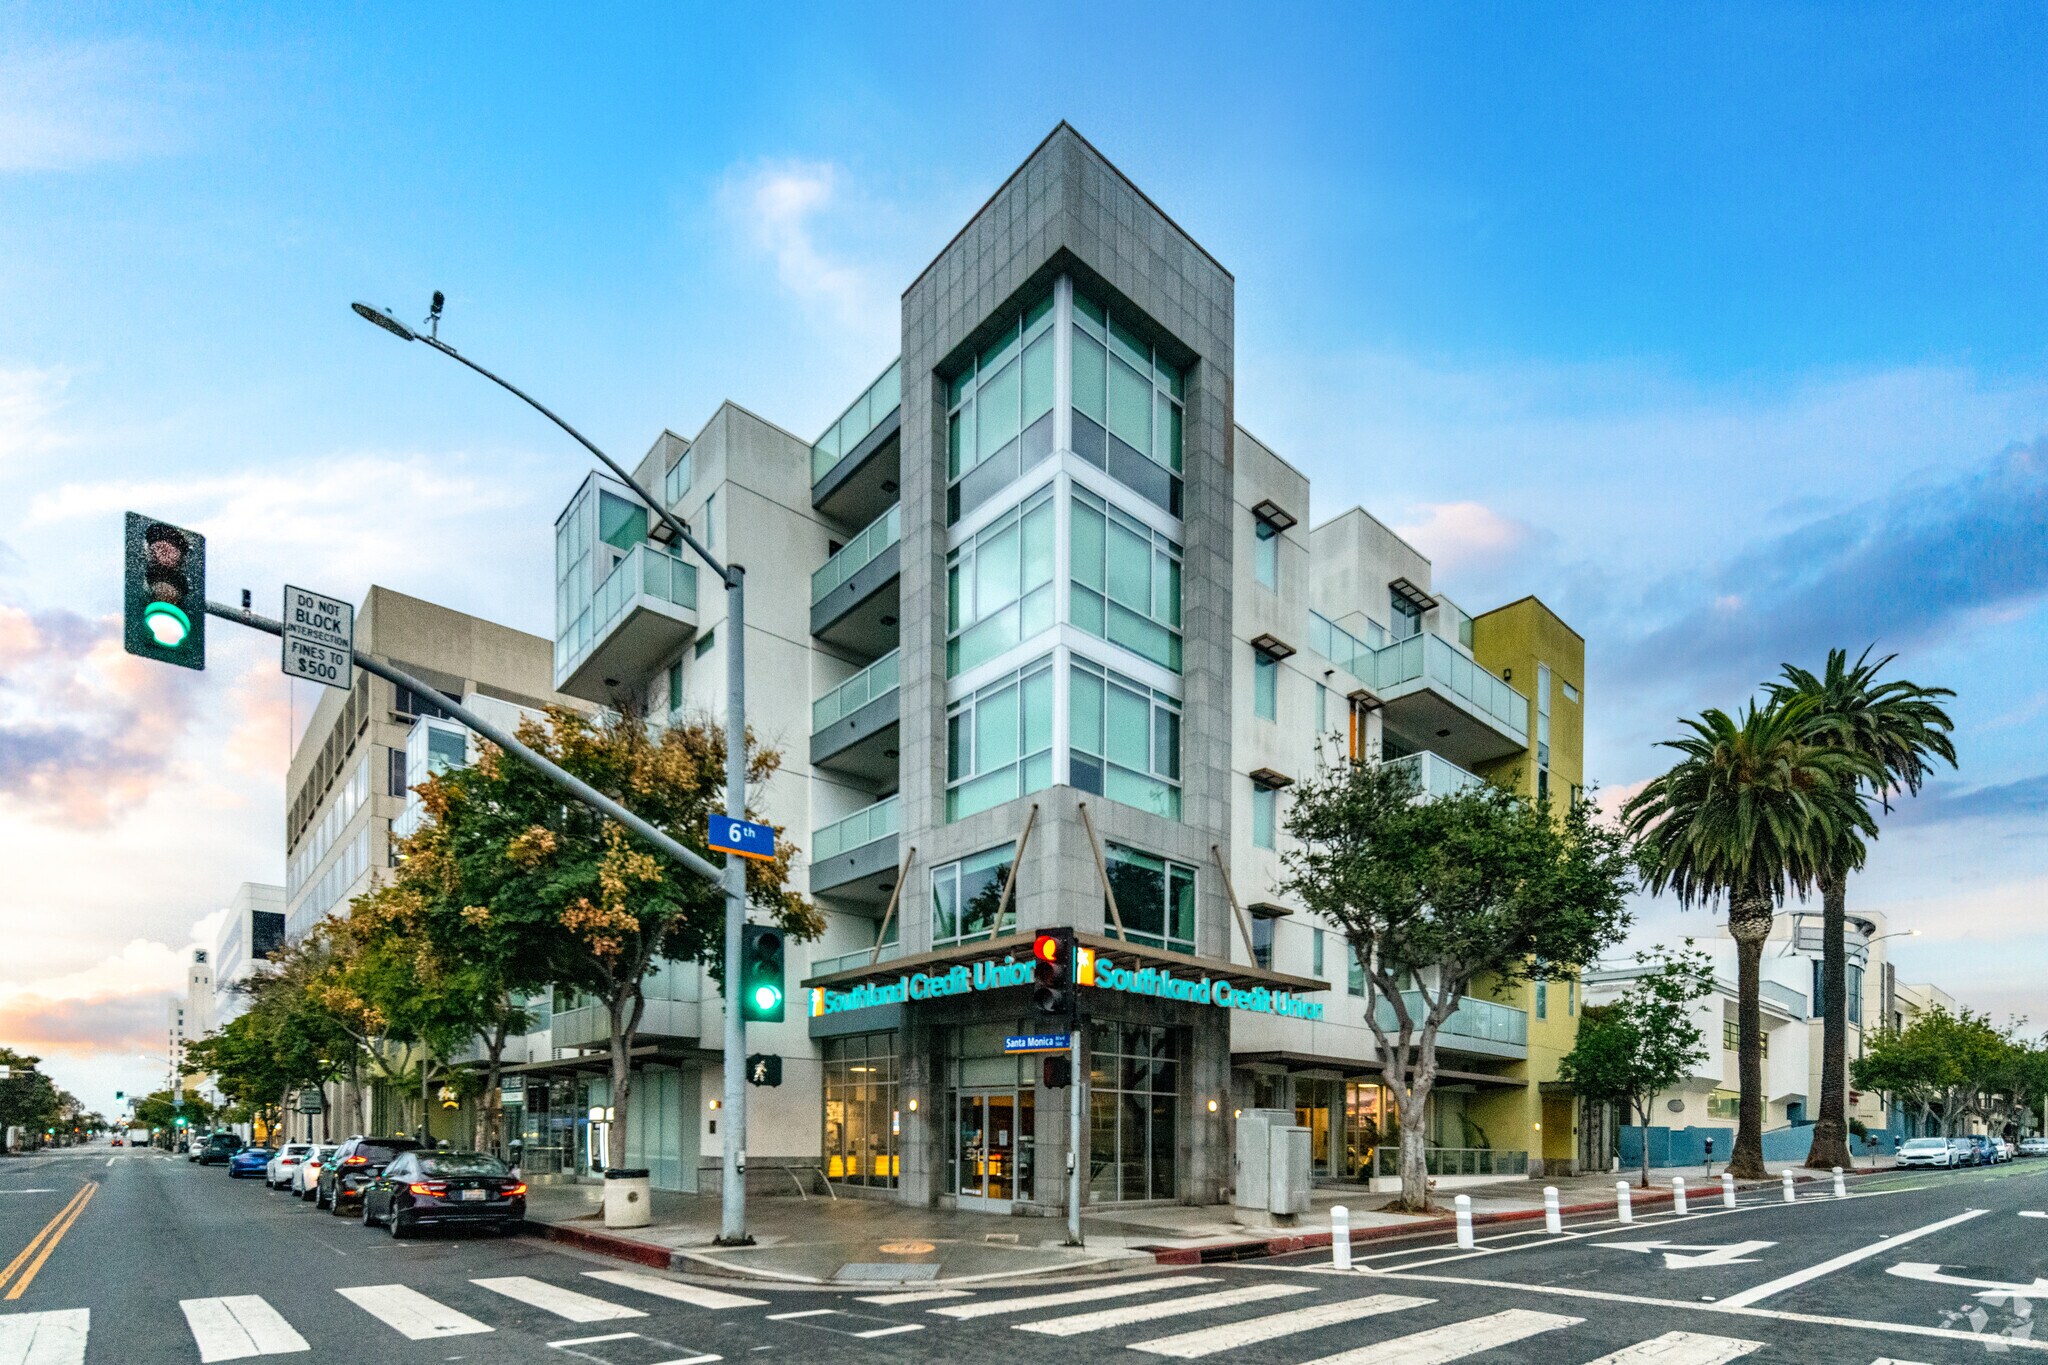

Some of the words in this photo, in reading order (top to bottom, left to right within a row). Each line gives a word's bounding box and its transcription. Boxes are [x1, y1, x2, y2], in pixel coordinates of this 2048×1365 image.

[297, 594, 314, 609] DO
[318, 600, 340, 616] NOT
[295, 607, 342, 634] BLOCK
[286, 623, 349, 647] INTERSECTION
[291, 641, 326, 661] FINES
[330, 651, 344, 666] TO
[298, 657, 337, 680] $500
[728, 822, 756, 843] 6th
[824, 976, 909, 1015] Southland
[909, 965, 971, 1000] Credit
[1094, 957, 1211, 1005] Southland
[1211, 980, 1272, 1013] Credit
[1272, 990, 1324, 1020] Union
[1006, 1038, 1026, 1048] Santa
[1027, 1036, 1054, 1047] Monica
